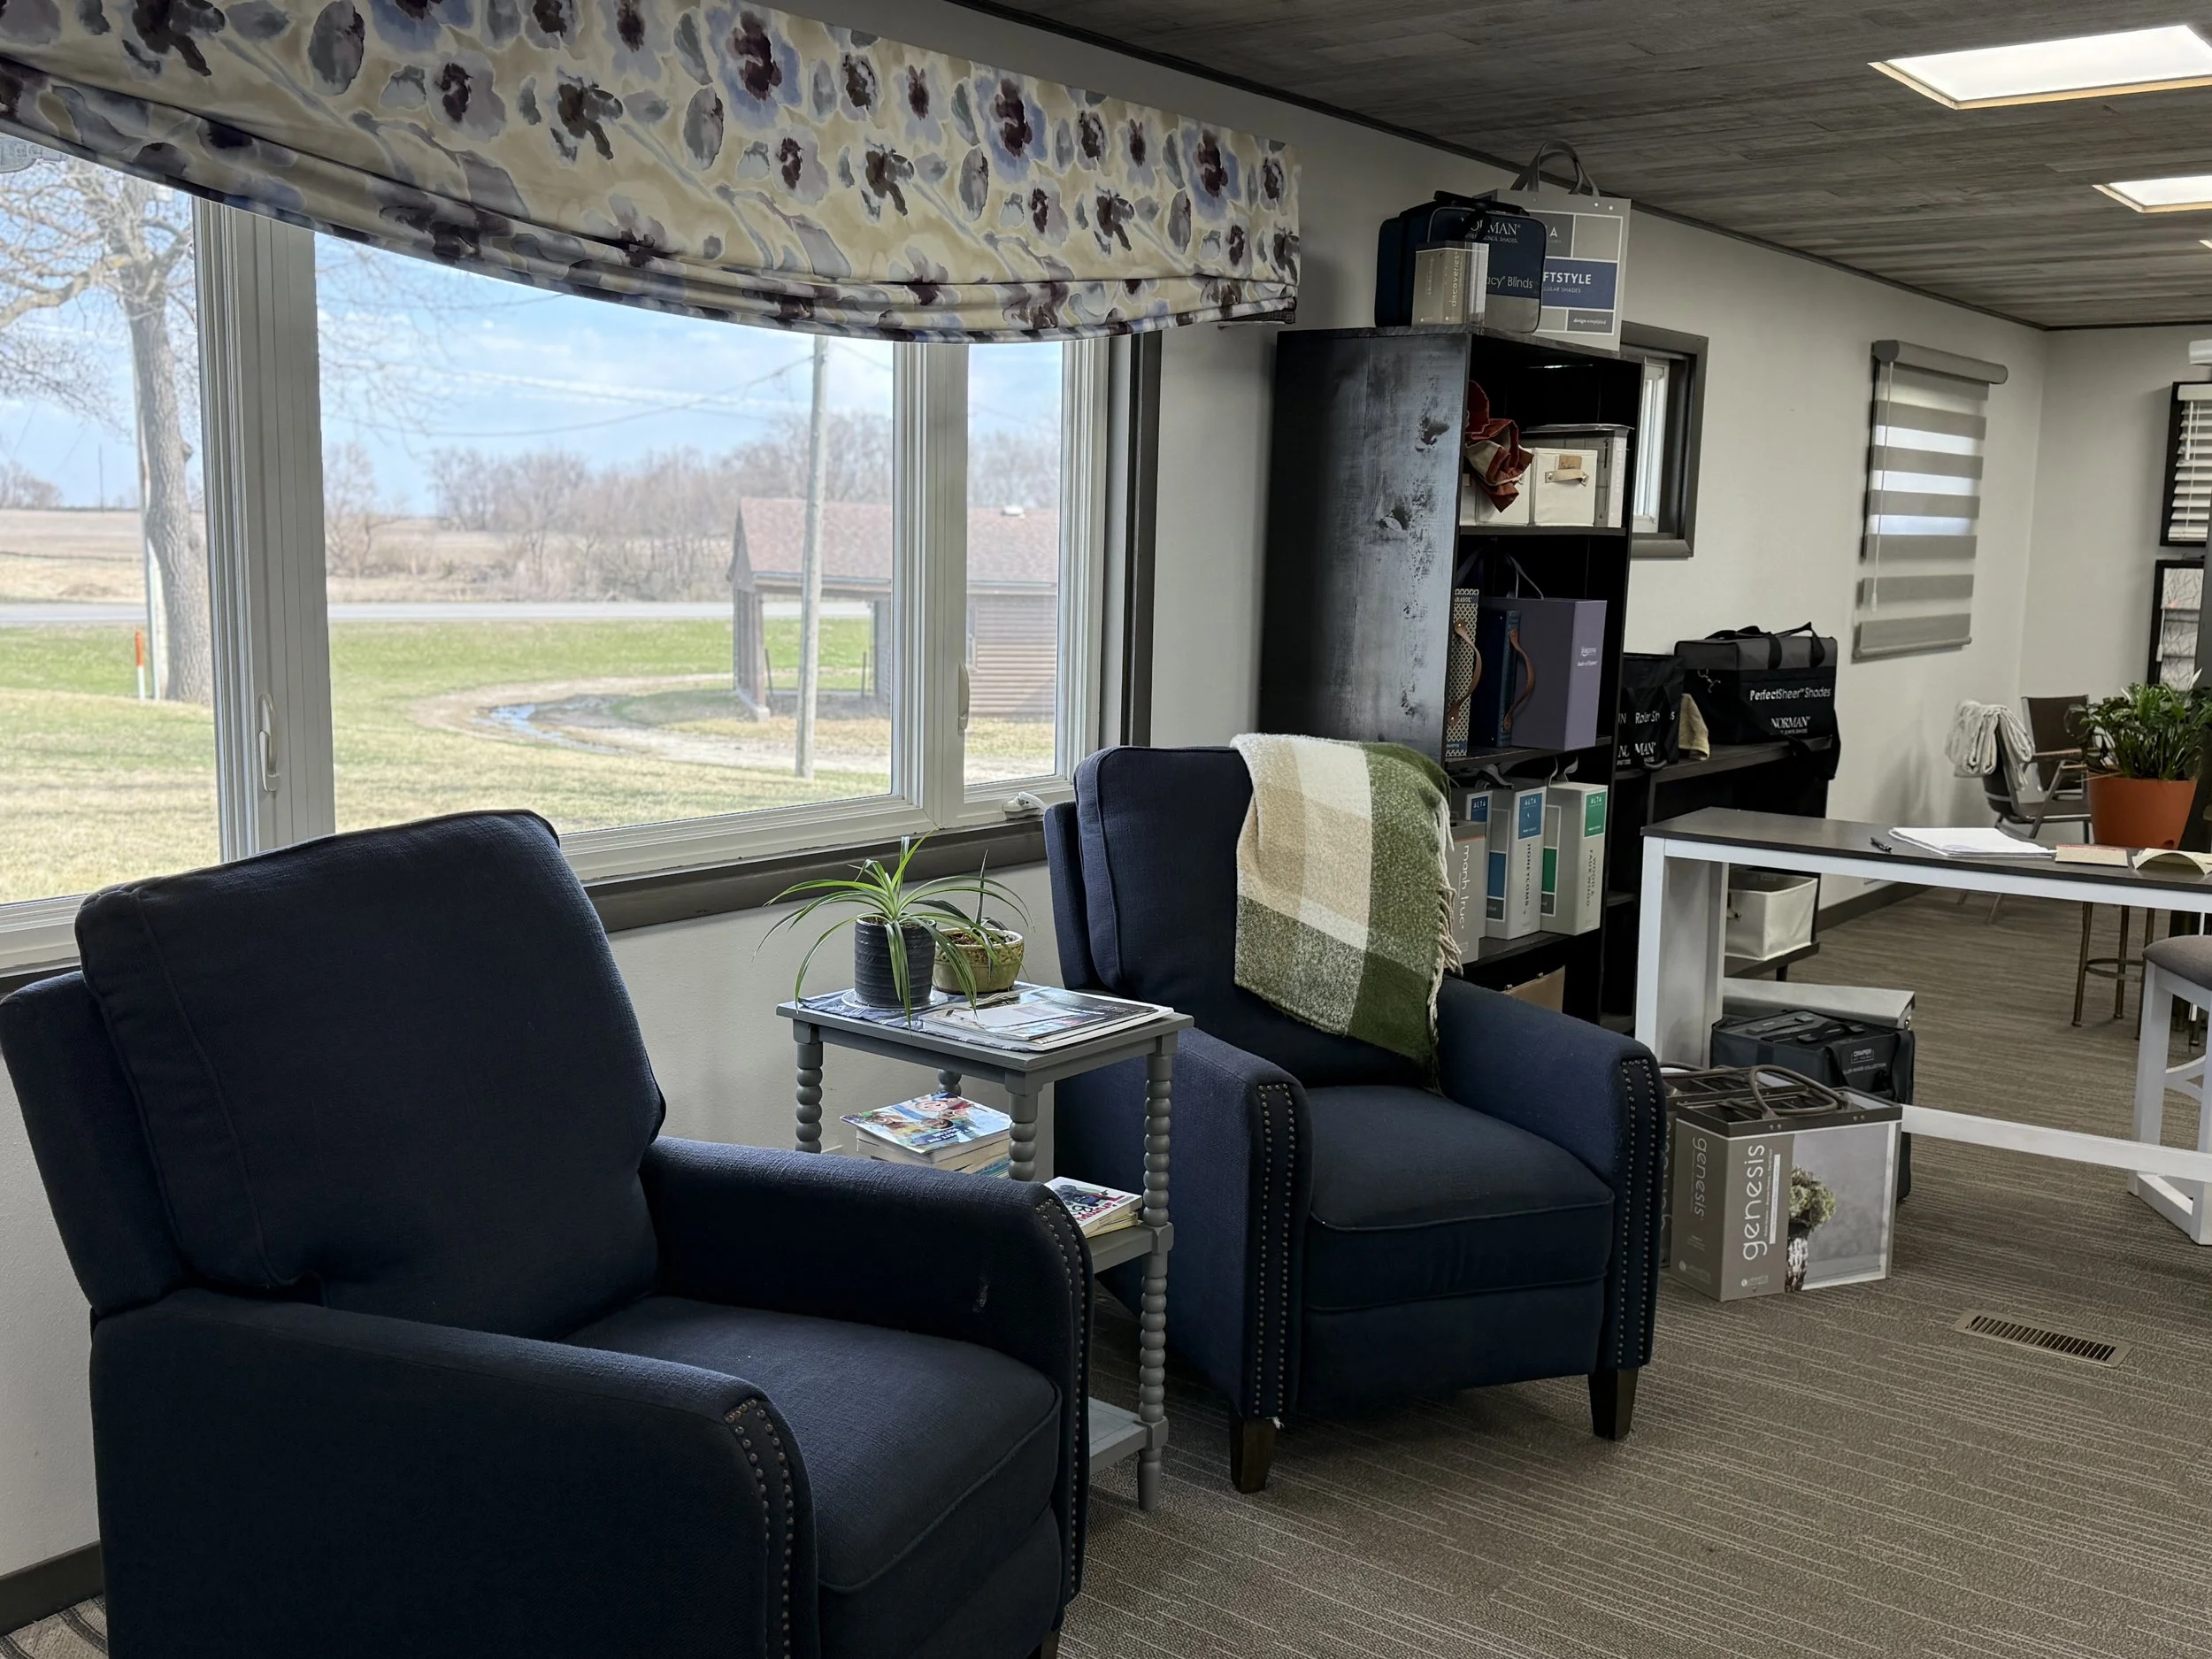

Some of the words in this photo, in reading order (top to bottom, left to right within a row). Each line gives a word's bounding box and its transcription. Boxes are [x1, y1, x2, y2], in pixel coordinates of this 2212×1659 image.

[1448, 251, 1460, 307] discoveries
[1507, 276, 1533, 289] Blinds
[1542, 271, 1592, 285] FTSTYLE
[1805, 687, 1831, 699] Shades
[1770, 716, 1810, 729] NORMAN
[1473, 799, 1487, 809] ALTA
[1525, 797, 1538, 806] ALTA
[1590, 795, 1602, 804] ALTA
[1460, 845, 1472, 891] manh
[1523, 843, 1532, 907] HONEYCOMB
[1692, 1137, 1708, 1221] genesis
[1742, 1144, 1768, 1261] genesis
